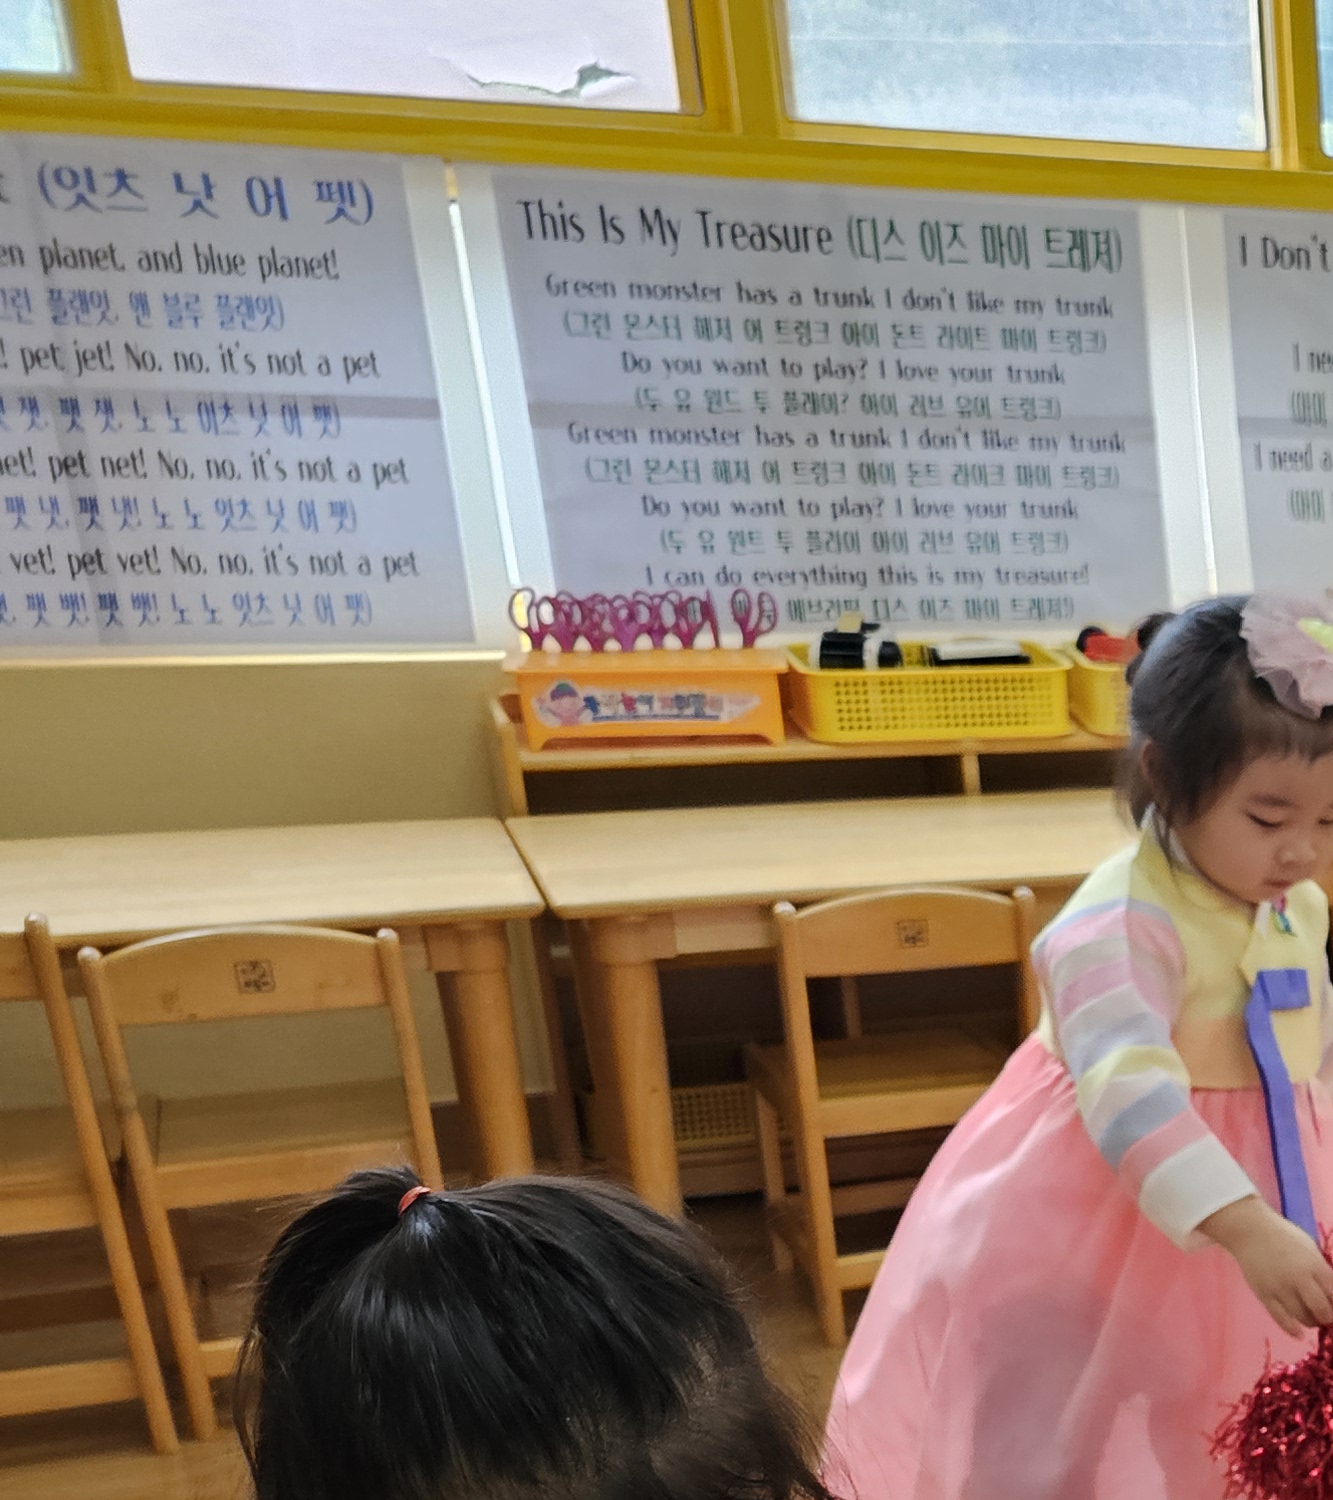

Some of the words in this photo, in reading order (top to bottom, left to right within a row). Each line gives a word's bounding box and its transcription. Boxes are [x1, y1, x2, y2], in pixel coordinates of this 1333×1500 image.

[37, 162, 149, 214] (잇츠
[172, 171, 219, 220] 낫
[245, 175, 289, 222] 어
[517, 200, 586, 244] This
[599, 202, 626, 245] Is
[640, 206, 682, 258] My
[694, 207, 834, 256] Treasure
[846, 214, 907, 264] (디스
[919, 220, 969, 266] 이즈
[981, 221, 1030, 270] 마이
[137, 240, 183, 274] and
[193, 242, 246, 276] blue
[258, 245, 340, 284] planet!
[1239, 235, 1248, 269] I
[1262, 232, 1332, 272] Don't
[545, 272, 617, 300] Green
[628, 280, 722, 302] monster
[736, 279, 778, 306] has
[788, 287, 803, 307] a
[813, 286, 876, 310] trunk
[884, 288, 892, 310] I
[902, 286, 957, 313] don't
[966, 289, 1005, 315] like
[1013, 295, 1044, 321] my
[1055, 295, 1114, 319] trunk
[73, 339, 115, 377] jet!
[219, 341, 256, 375] it's
[267, 348, 307, 377] not
[317, 357, 331, 377] a
[343, 351, 381, 384] pet
[621, 350, 651, 374] Do
[662, 358, 702, 380] you
[712, 357, 769, 377] want
[780, 358, 803, 379] to
[813, 356, 868, 384] play?
[879, 359, 886, 379] I
[895, 359, 939, 381] love
[949, 369, 993, 387] your
[1006, 363, 1066, 385] trunk
[568, 422, 638, 445] Green
[650, 424, 743, 447] monster
[755, 424, 795, 448] has
[805, 432, 819, 447] a
[830, 427, 892, 449] trunk
[901, 428, 908, 448] I
[918, 426, 971, 451] don't
[981, 429, 1020, 452] like
[1028, 435, 1060, 455] my
[1069, 431, 1126, 455] trunk
[48, 449, 91, 483] pet
[100, 447, 148, 480] net!
[251, 448, 287, 482] it's
[298, 456, 337, 483] not
[347, 463, 361, 483] a
[373, 456, 410, 489] pet
[642, 494, 670, 517] Do
[681, 500, 721, 521] you
[730, 498, 787, 517] want
[798, 497, 821, 517] to
[831, 496, 885, 522] play?
[896, 496, 903, 516] I
[912, 496, 955, 519] love
[964, 504, 1008, 523] your
[1020, 497, 1079, 521] trunk
[9, 544, 56, 575] vet!
[68, 547, 108, 581] pet
[117, 544, 162, 576] vet!
[263, 542, 299, 577] it's
[310, 549, 349, 577] not
[358, 558, 371, 577] a
[384, 550, 420, 583] pet
[645, 564, 653, 586] I
[664, 570, 705, 586] can
[715, 564, 743, 586] do
[753, 563, 868, 590] everything
[877, 563, 918, 586] this
[927, 562, 945, 586] is
[953, 568, 985, 590] my
